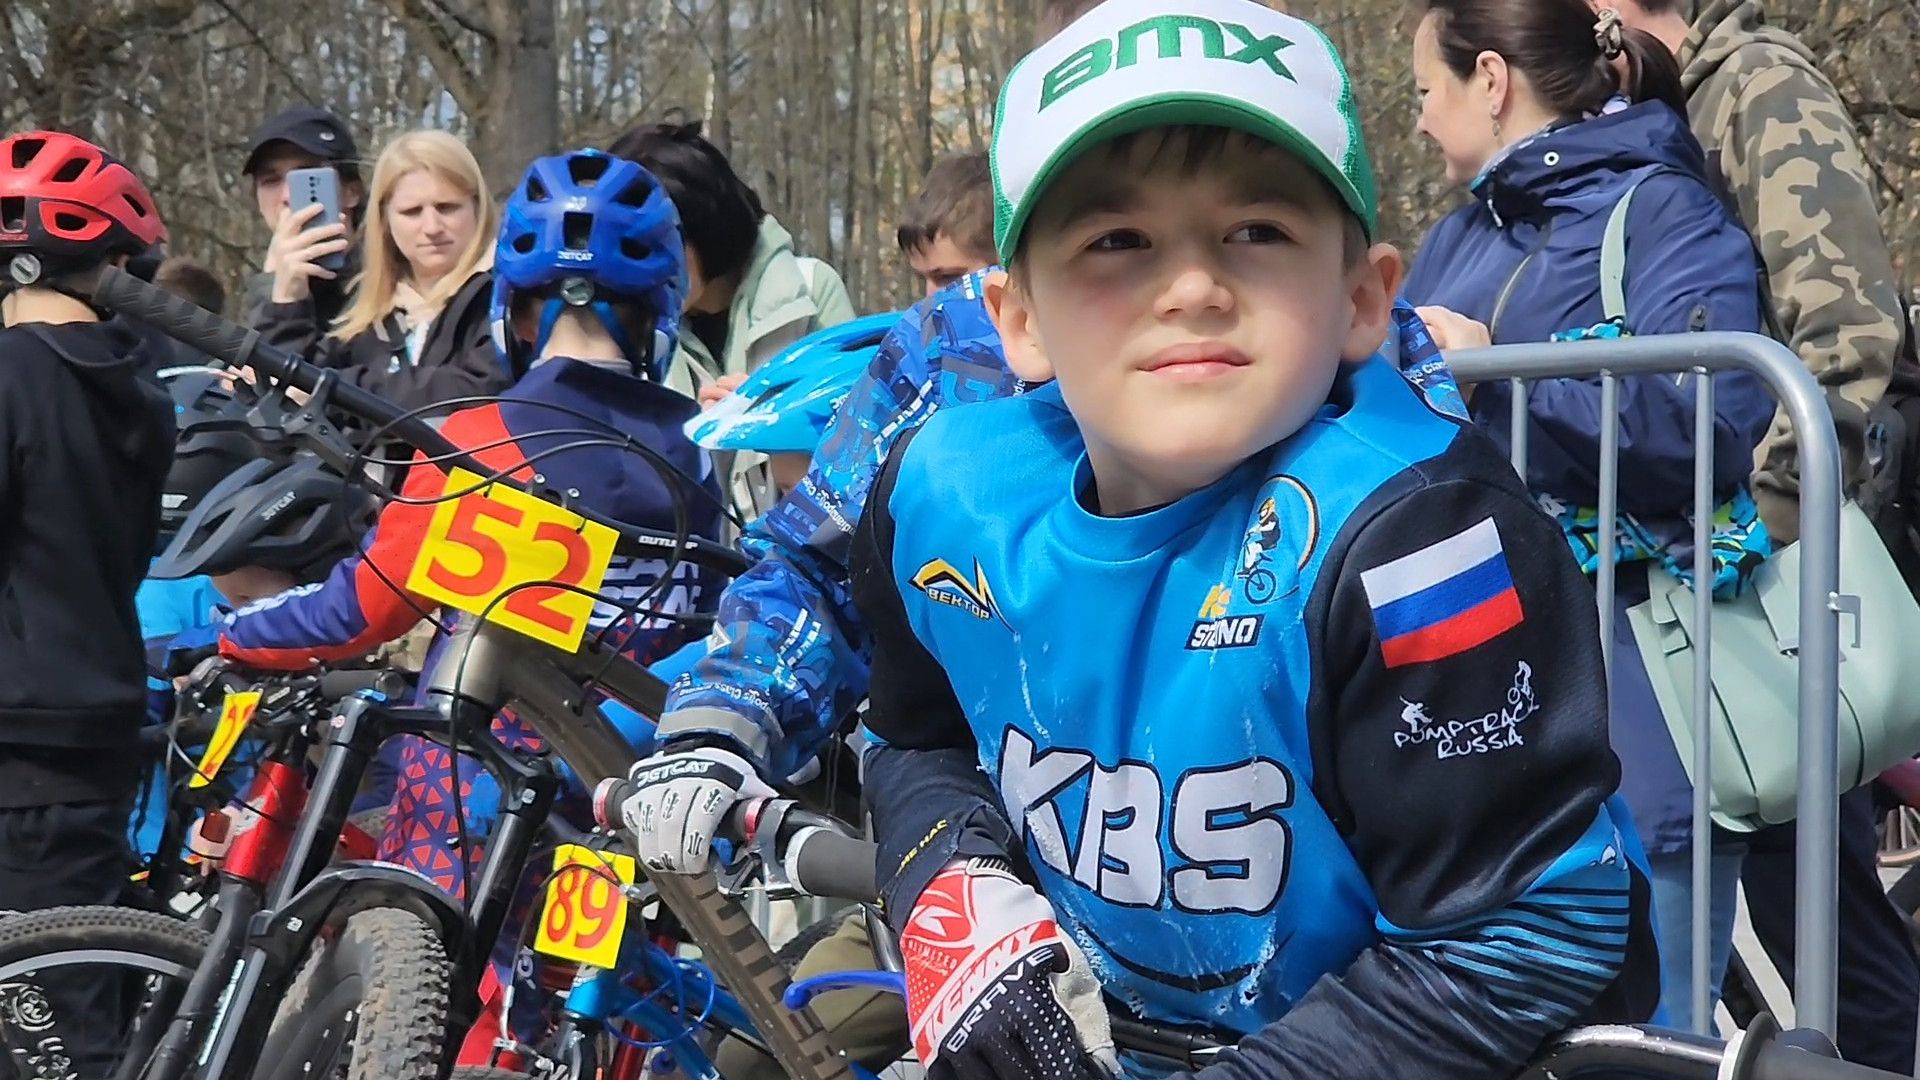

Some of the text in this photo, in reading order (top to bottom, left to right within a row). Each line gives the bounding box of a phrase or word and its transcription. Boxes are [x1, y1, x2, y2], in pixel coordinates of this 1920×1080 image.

[427, 492, 592, 636] 52
[637, 759, 716, 788] JETCAT
[1437, 726, 1524, 759] RUSSIA
[999, 722, 1294, 918] KBS
[546, 858, 622, 949] 89
[946, 946, 1055, 1053] BRAVE
